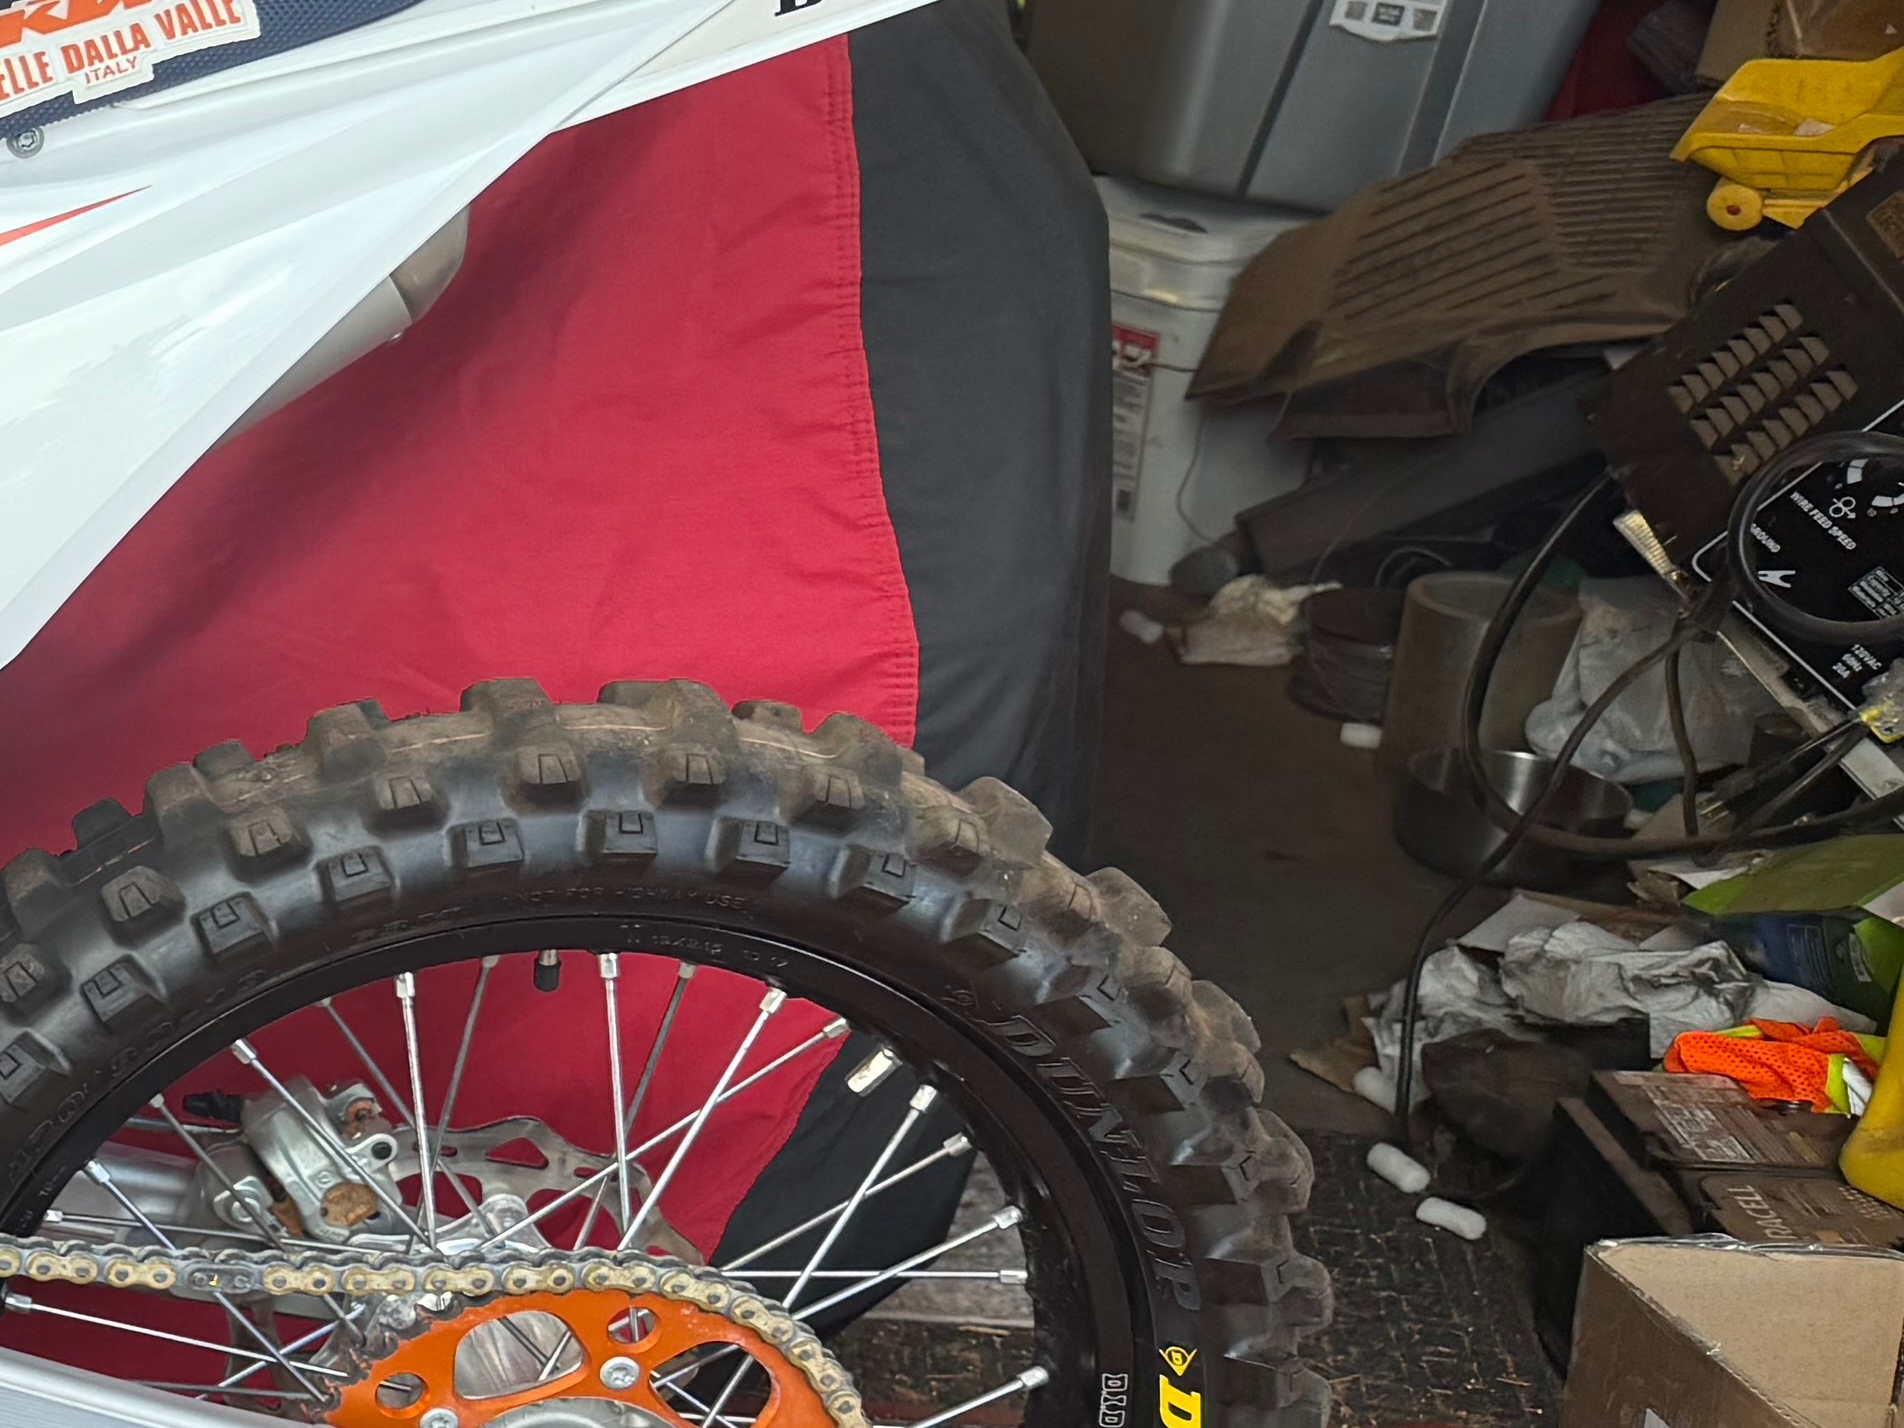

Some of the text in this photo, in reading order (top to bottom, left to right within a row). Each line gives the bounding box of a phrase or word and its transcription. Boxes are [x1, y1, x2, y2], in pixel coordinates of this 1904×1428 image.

[61, 20, 153, 77] DALLA
[83, 54, 139, 87] ITALY
[1789, 491, 1857, 551] WIRE FEED SPEED
[1728, 1184, 1798, 1239] RACELL
